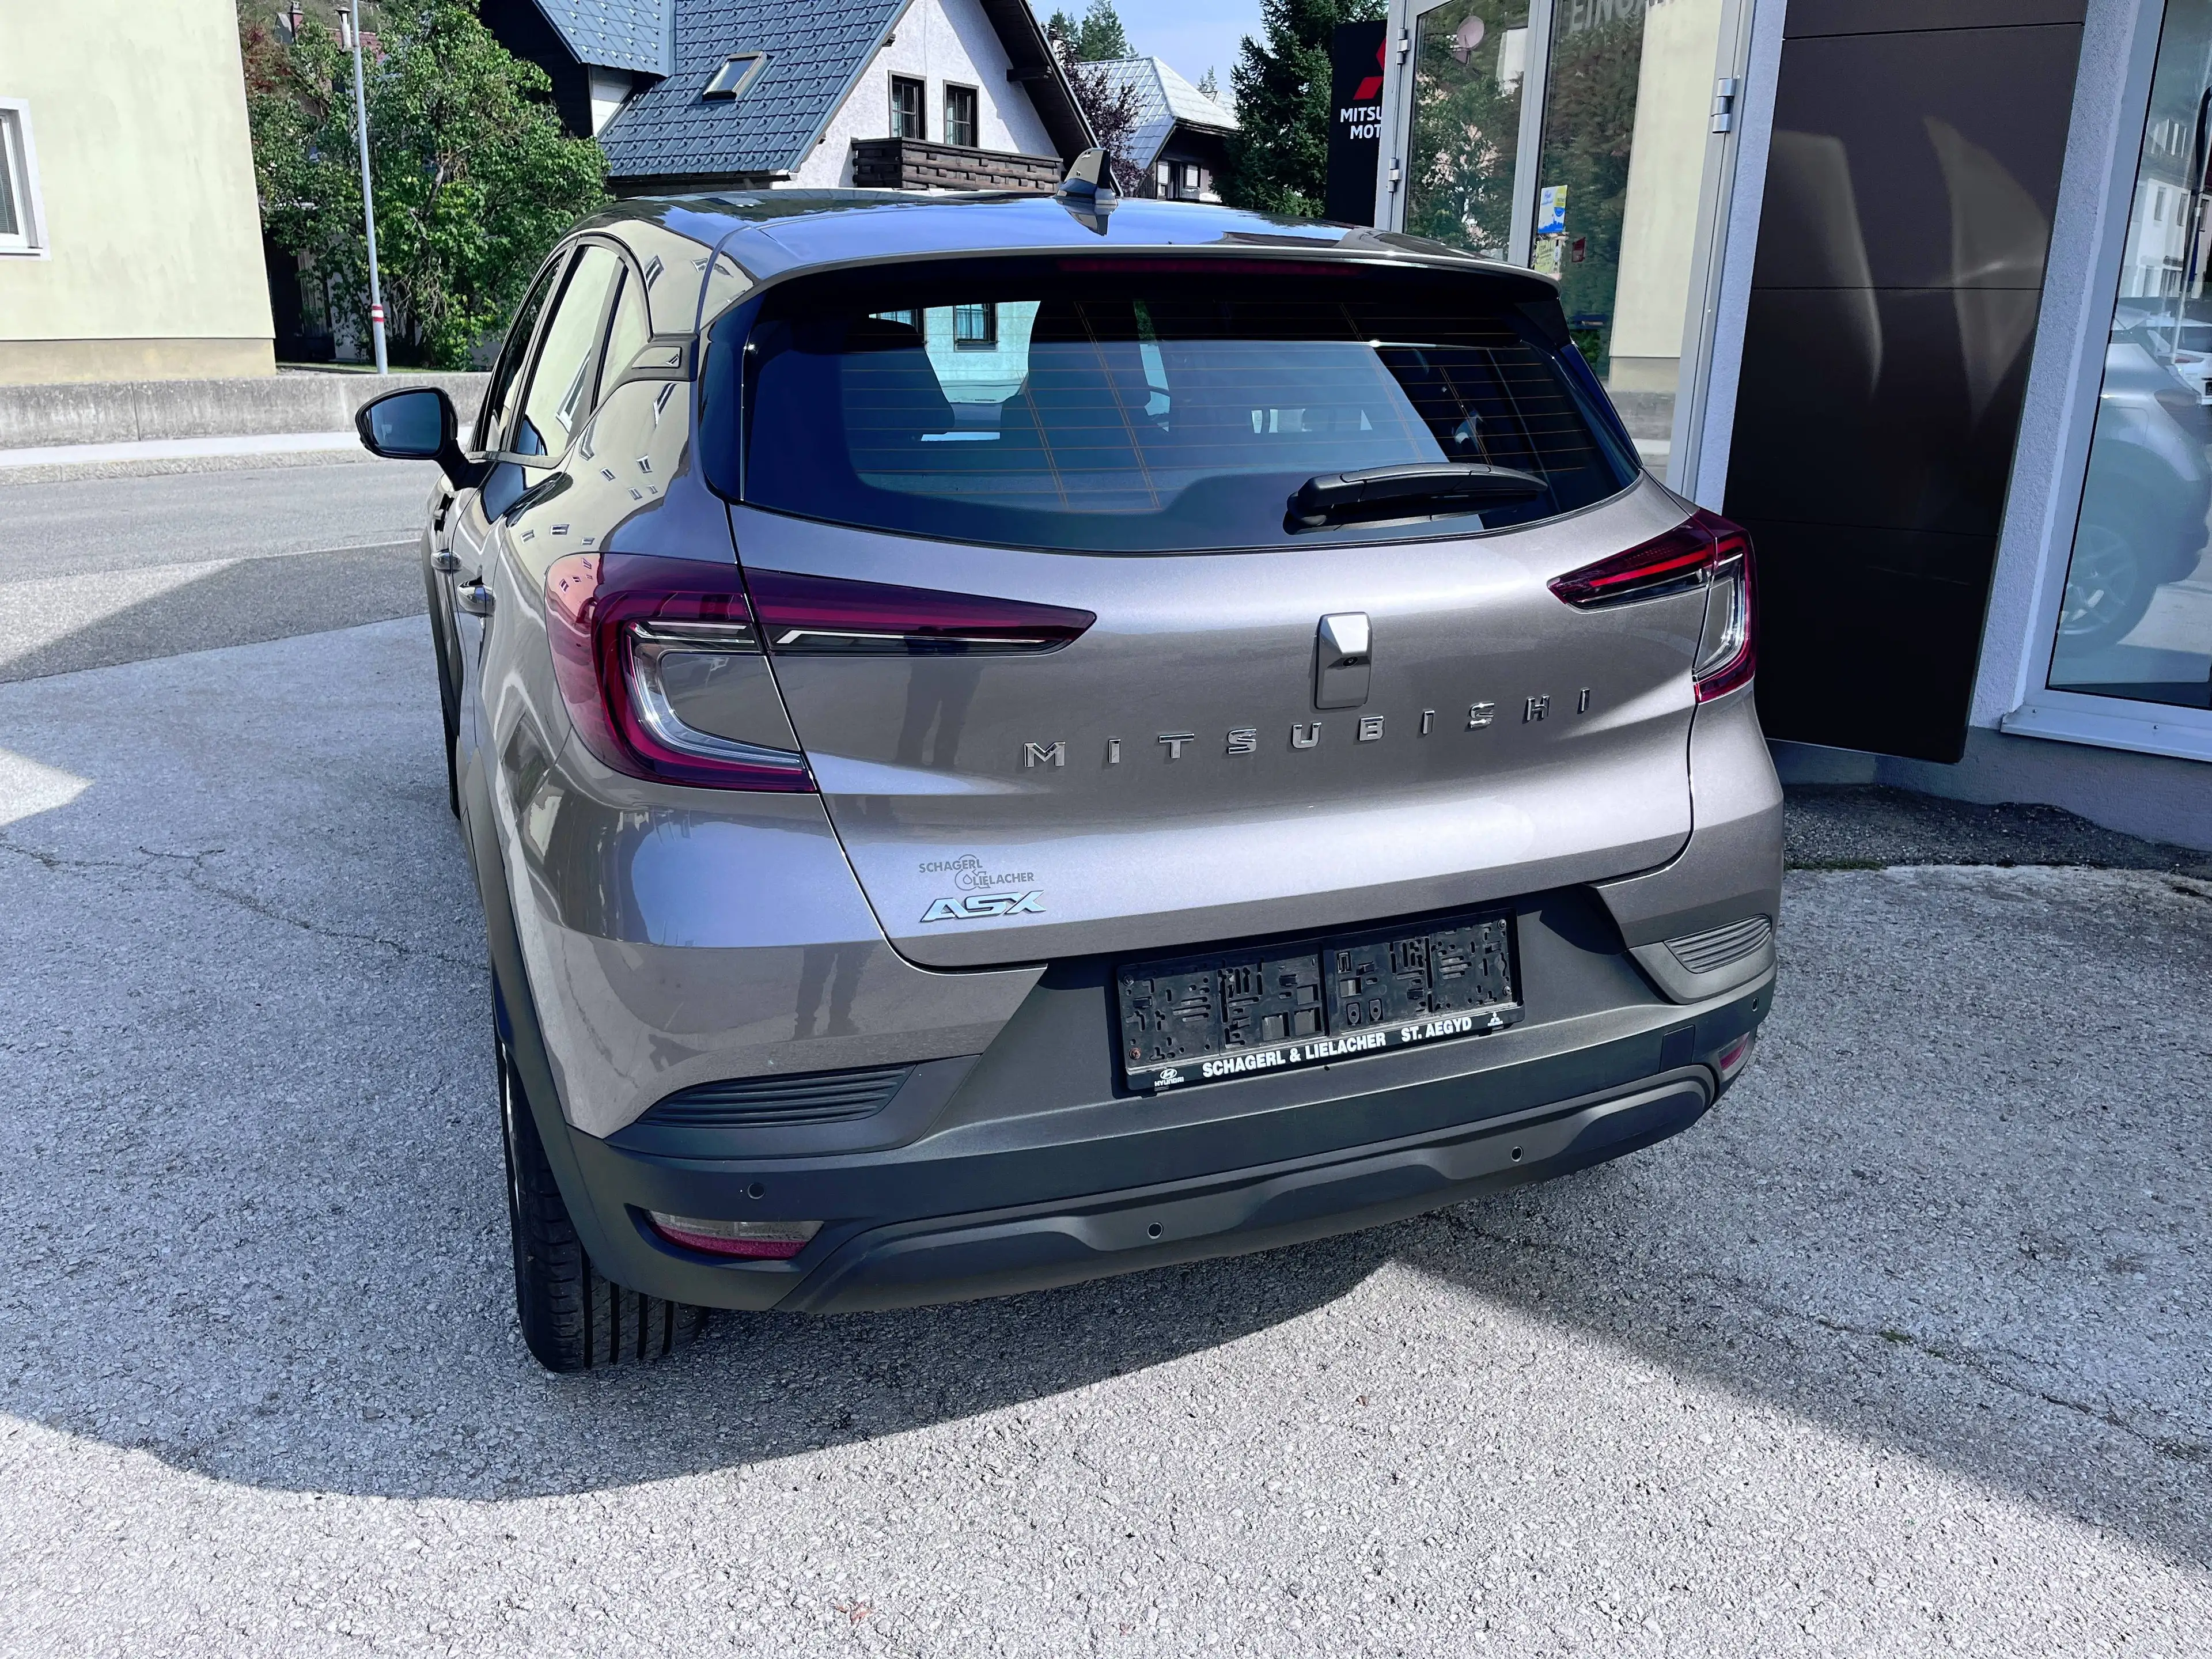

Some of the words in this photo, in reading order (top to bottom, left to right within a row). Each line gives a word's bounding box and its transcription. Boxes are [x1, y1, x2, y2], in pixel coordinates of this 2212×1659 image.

[1024, 687, 1591, 768] MITSUBISHI
[919, 859, 983, 873] SCHAGERL
[973, 872, 1035, 886] LIELACHER
[919, 889, 1047, 923] ASX
[1202, 1050, 1286, 1078] SCHAGERL
[1289, 1047, 1301, 1063] &
[1305, 1032, 1387, 1060] LIELACHER
[1401, 1025, 1422, 1043] ST.
[1426, 1016, 1472, 1038] AEGYD
[1154, 1076, 1184, 1087] HYUNDAI
